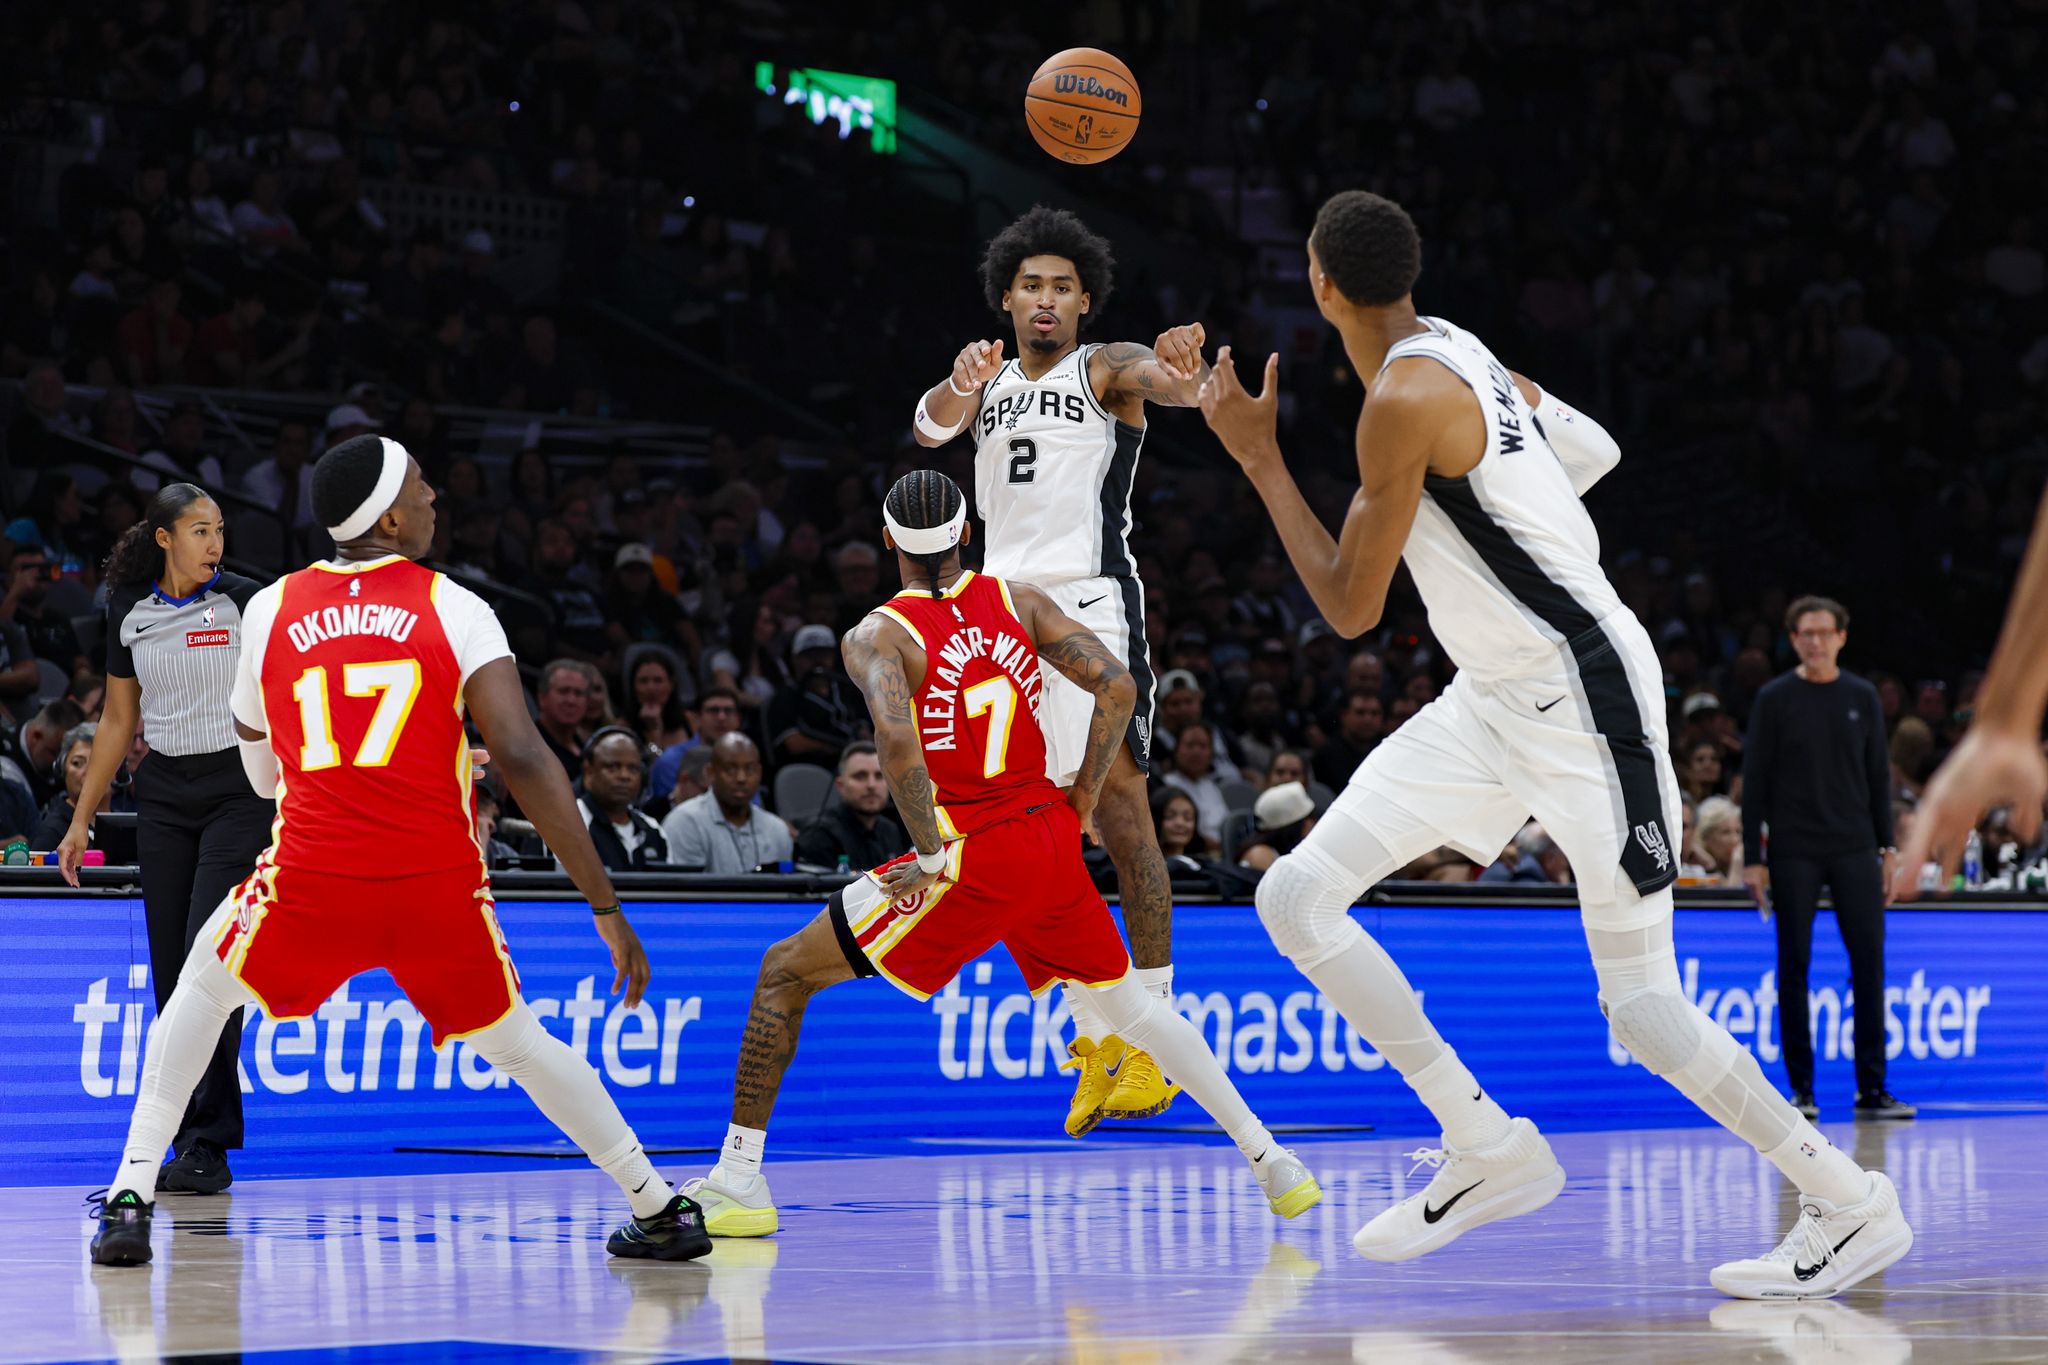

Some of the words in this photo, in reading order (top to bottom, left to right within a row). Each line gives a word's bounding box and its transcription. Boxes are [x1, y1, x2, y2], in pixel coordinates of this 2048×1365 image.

[1055, 74, 1128, 108] Wilson
[982, 390, 1085, 437] SPURS
[1007, 437, 1038, 485] 2
[187, 633, 228, 645] Emirates
[287, 604, 419, 653] OKONGWU
[292, 658, 422, 772] 17
[963, 674, 1018, 779] 7
